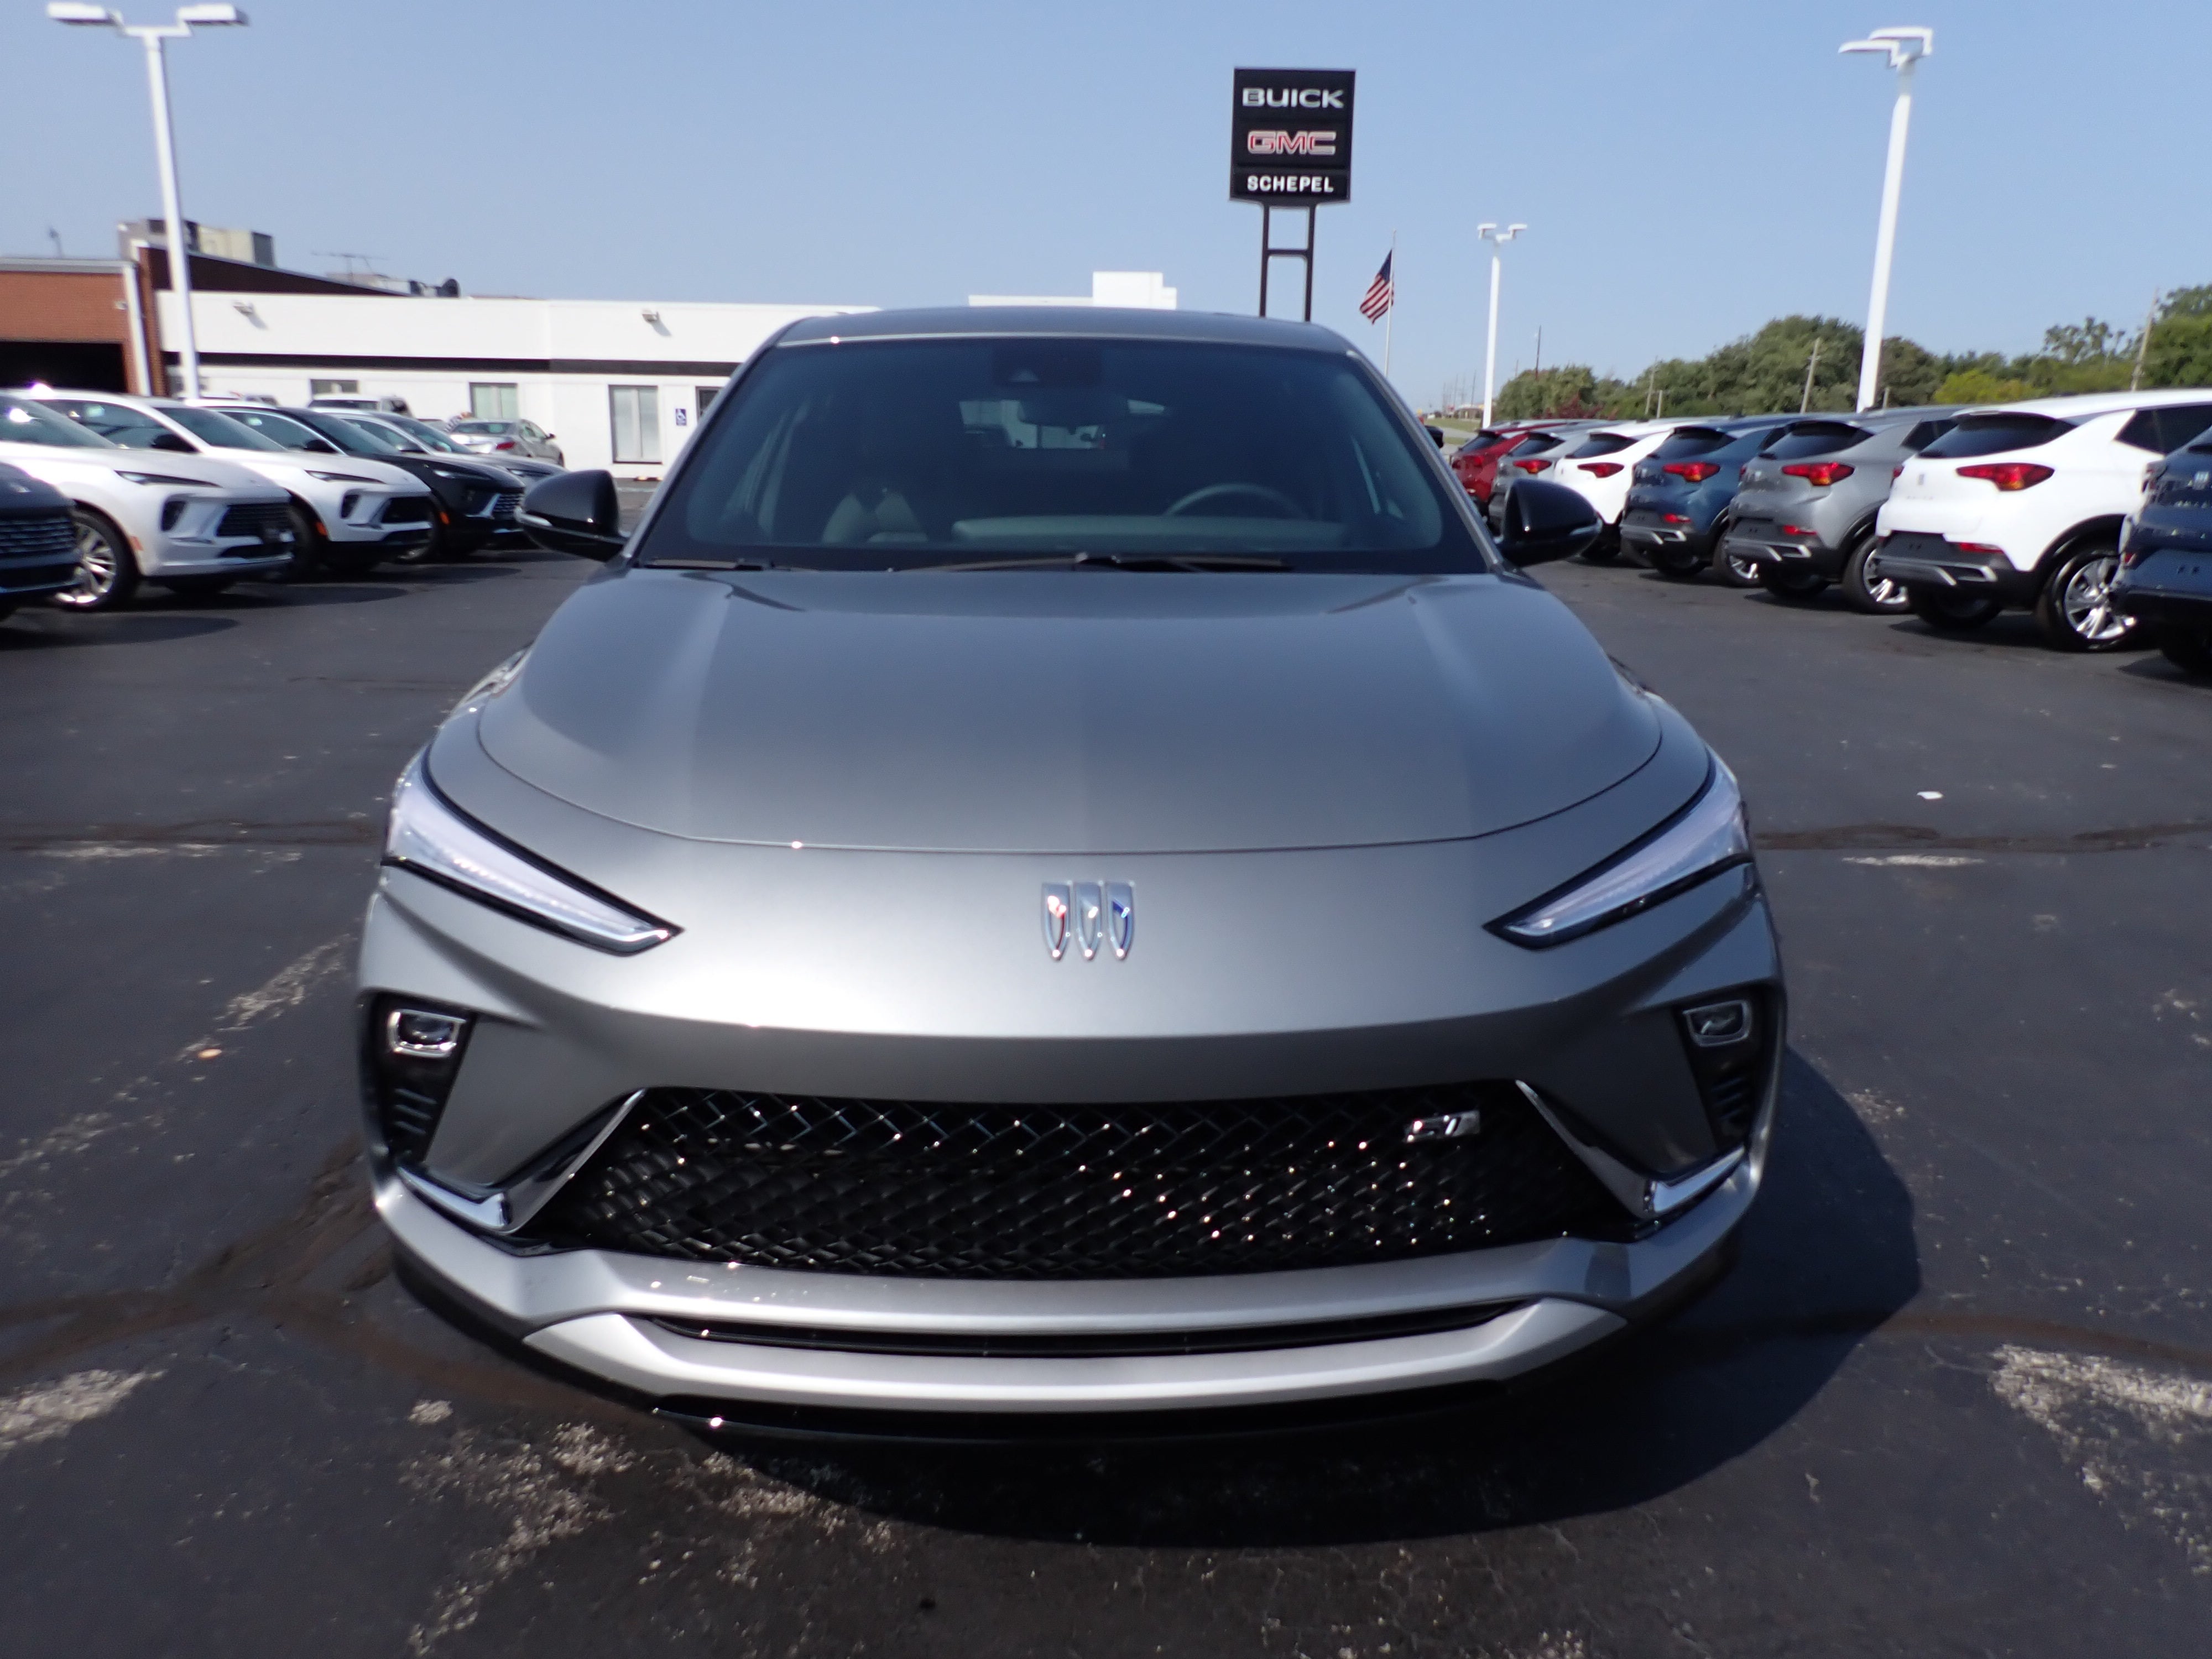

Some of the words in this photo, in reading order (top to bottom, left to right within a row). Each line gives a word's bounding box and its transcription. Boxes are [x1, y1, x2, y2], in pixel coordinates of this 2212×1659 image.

[1242, 87, 1344, 109] BUICK
[1248, 130, 1337, 155] GMC
[1246, 174, 1334, 193] SCHEPEL
